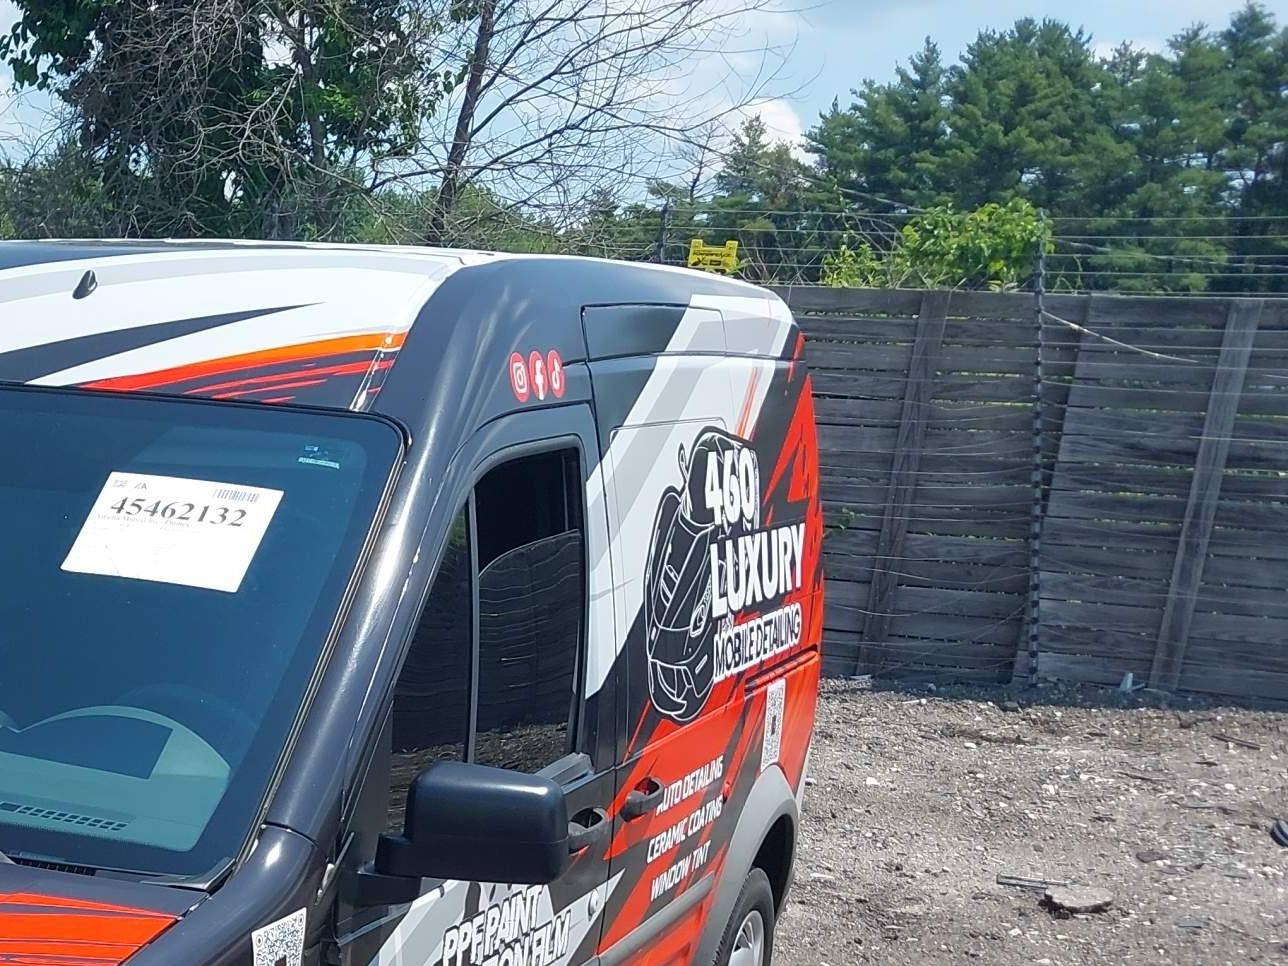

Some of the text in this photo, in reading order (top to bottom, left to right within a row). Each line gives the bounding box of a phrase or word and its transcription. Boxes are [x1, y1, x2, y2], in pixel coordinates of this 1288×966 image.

[110, 496, 247, 527] 45462132
[704, 448, 756, 525] 460
[710, 523, 805, 618] LUXURY
[714, 604, 801, 679] MOBILE DETAILING
[656, 755, 724, 816] AUTO DETAILING
[646, 795, 723, 863] CERAMIC COATING
[650, 840, 711, 902] WINDOW TINT
